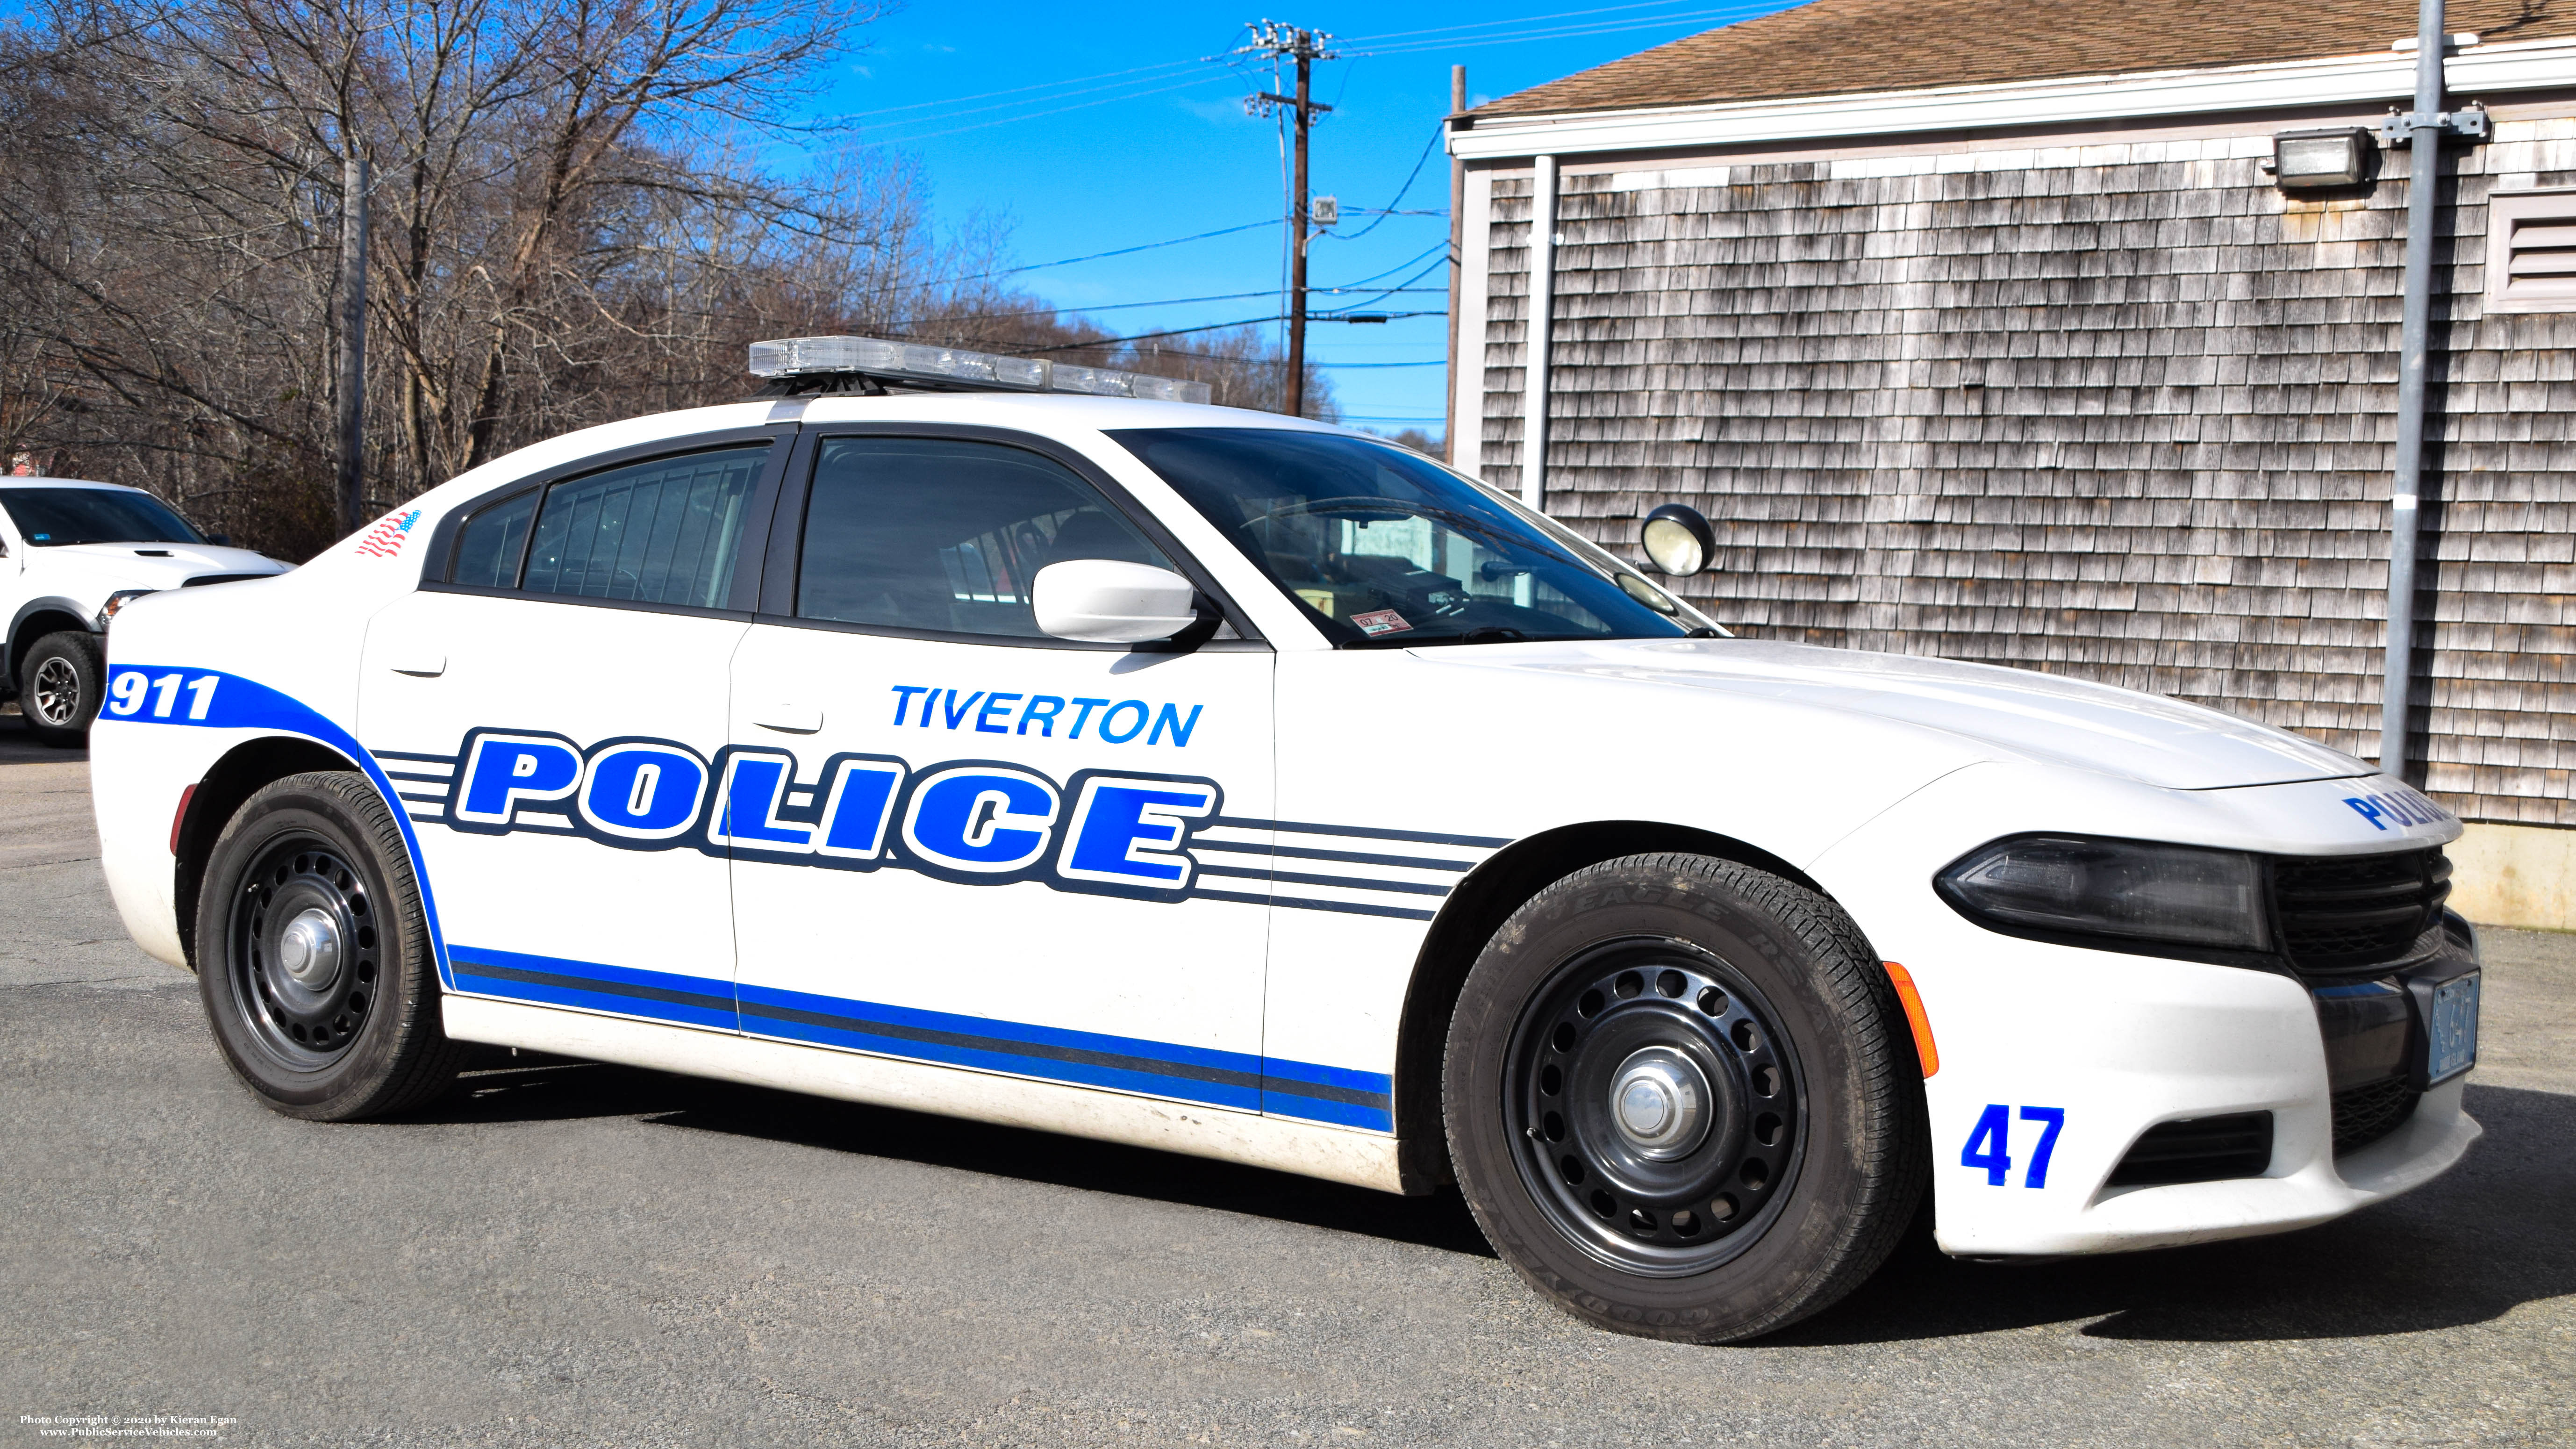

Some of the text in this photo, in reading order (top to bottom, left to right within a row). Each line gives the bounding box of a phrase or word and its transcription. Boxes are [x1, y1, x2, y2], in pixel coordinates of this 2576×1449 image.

[110, 671, 220, 720] 911
[892, 685, 1204, 747] TIVERTON
[461, 738, 1211, 883] POLICE
[1573, 888, 1730, 922] EAGLE
[1961, 1104, 2065, 1189] 47
